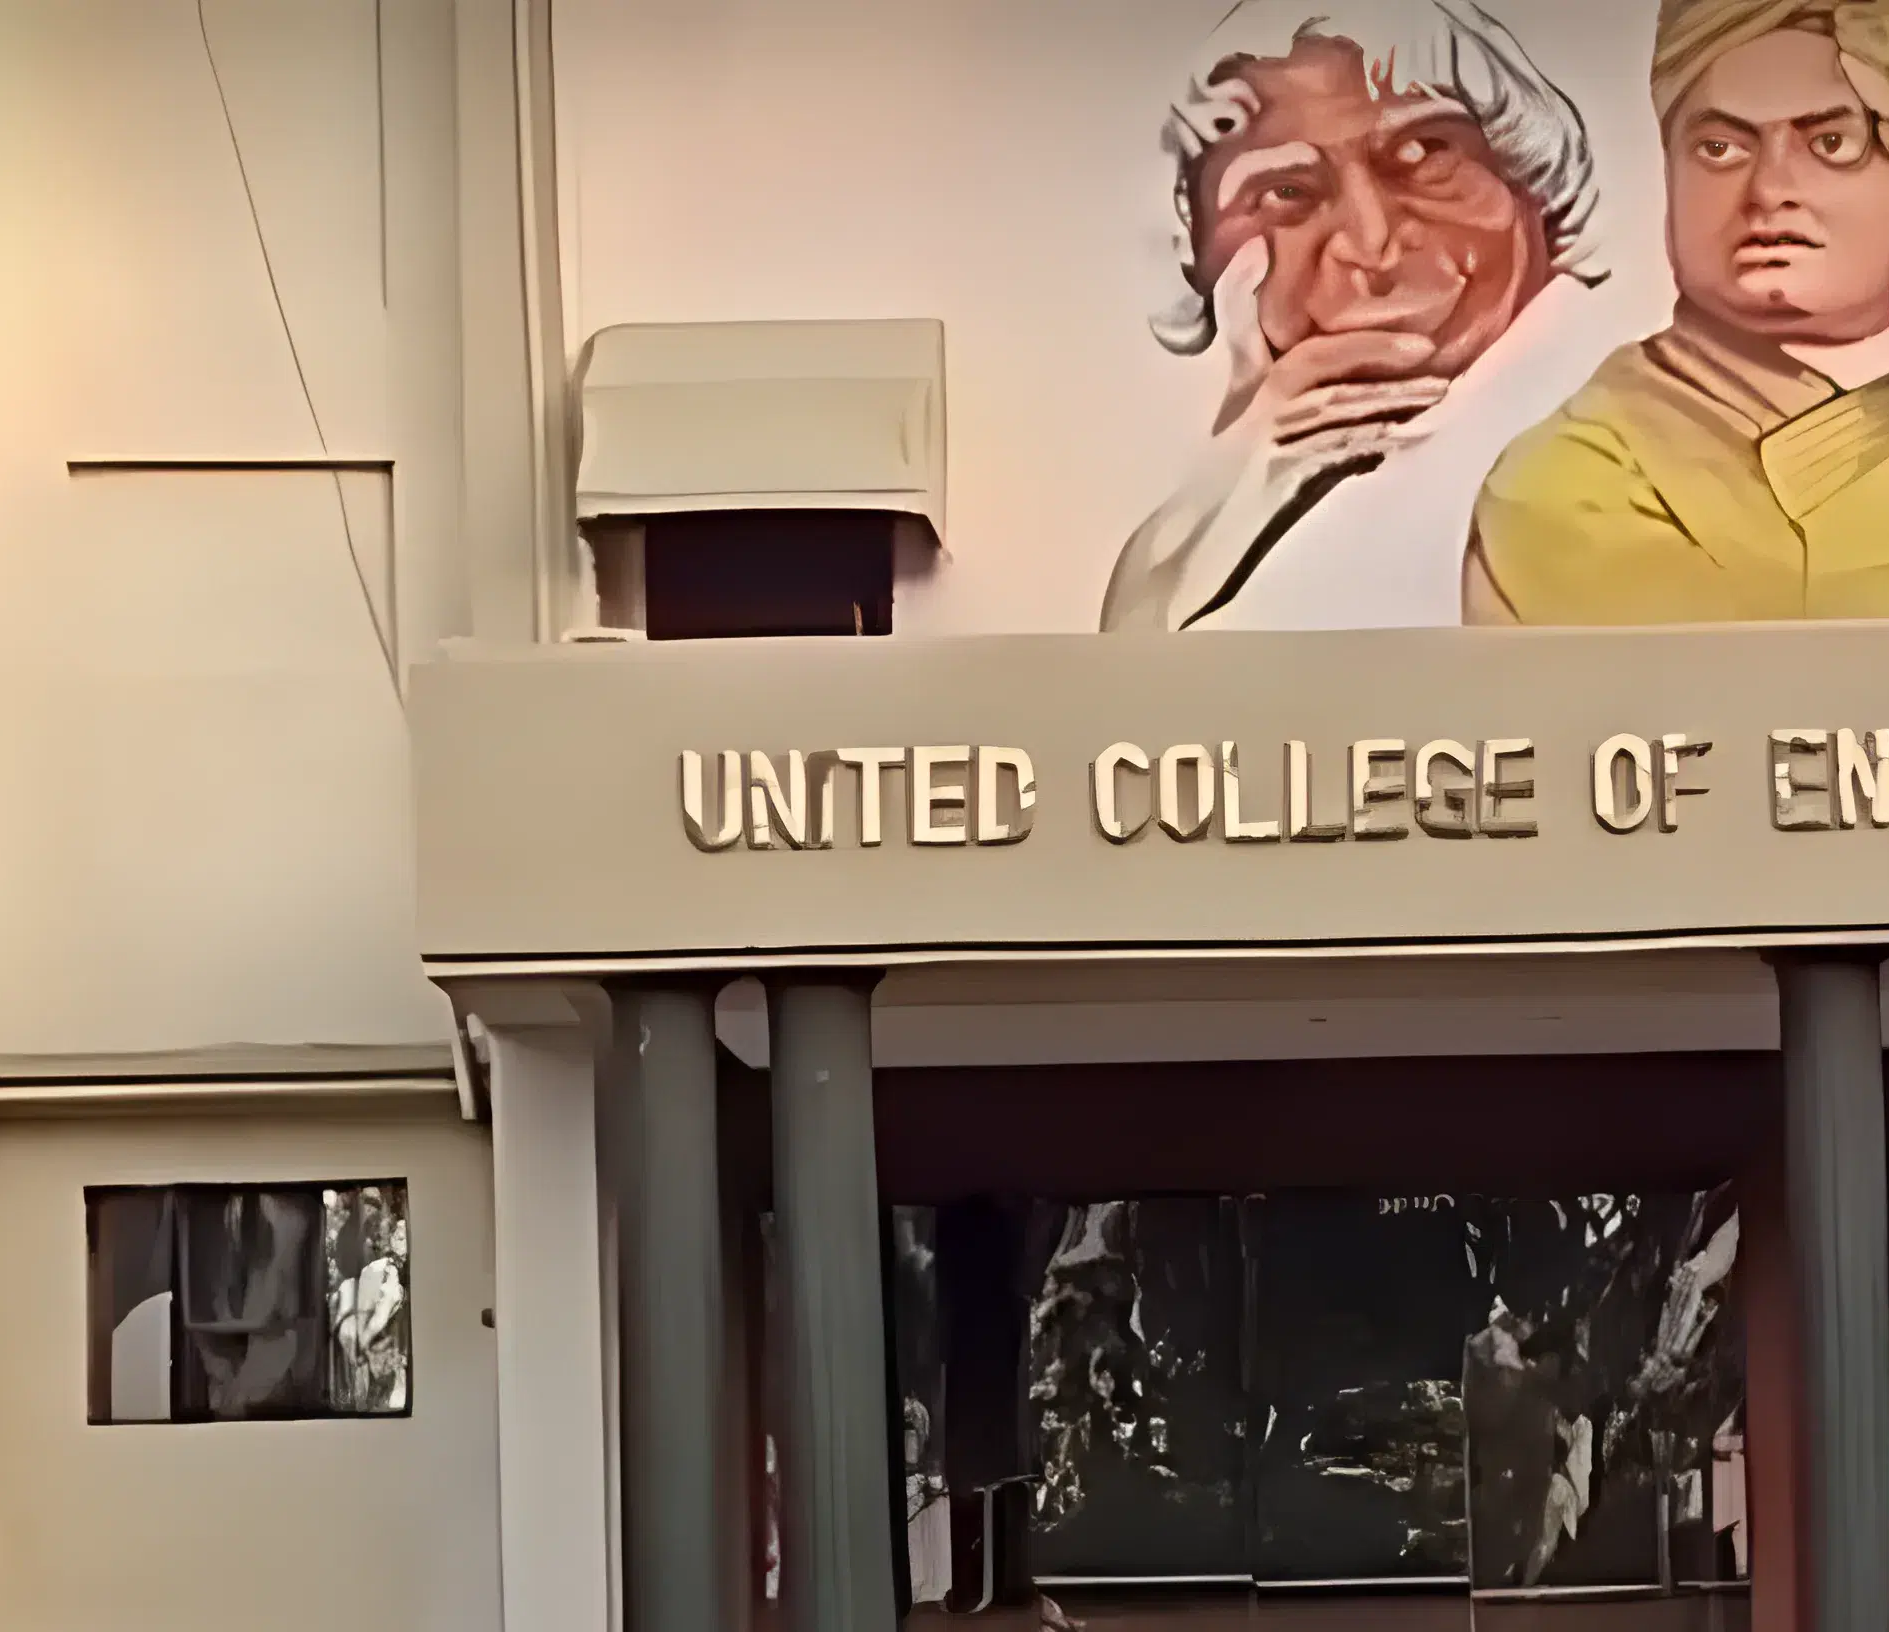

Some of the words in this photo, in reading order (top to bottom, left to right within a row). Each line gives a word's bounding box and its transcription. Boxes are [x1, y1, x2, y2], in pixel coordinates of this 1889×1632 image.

[678, 744, 1037, 852] UNITED
[1092, 738, 1539, 844] COLLEGE
[1591, 731, 1712, 835] OF
